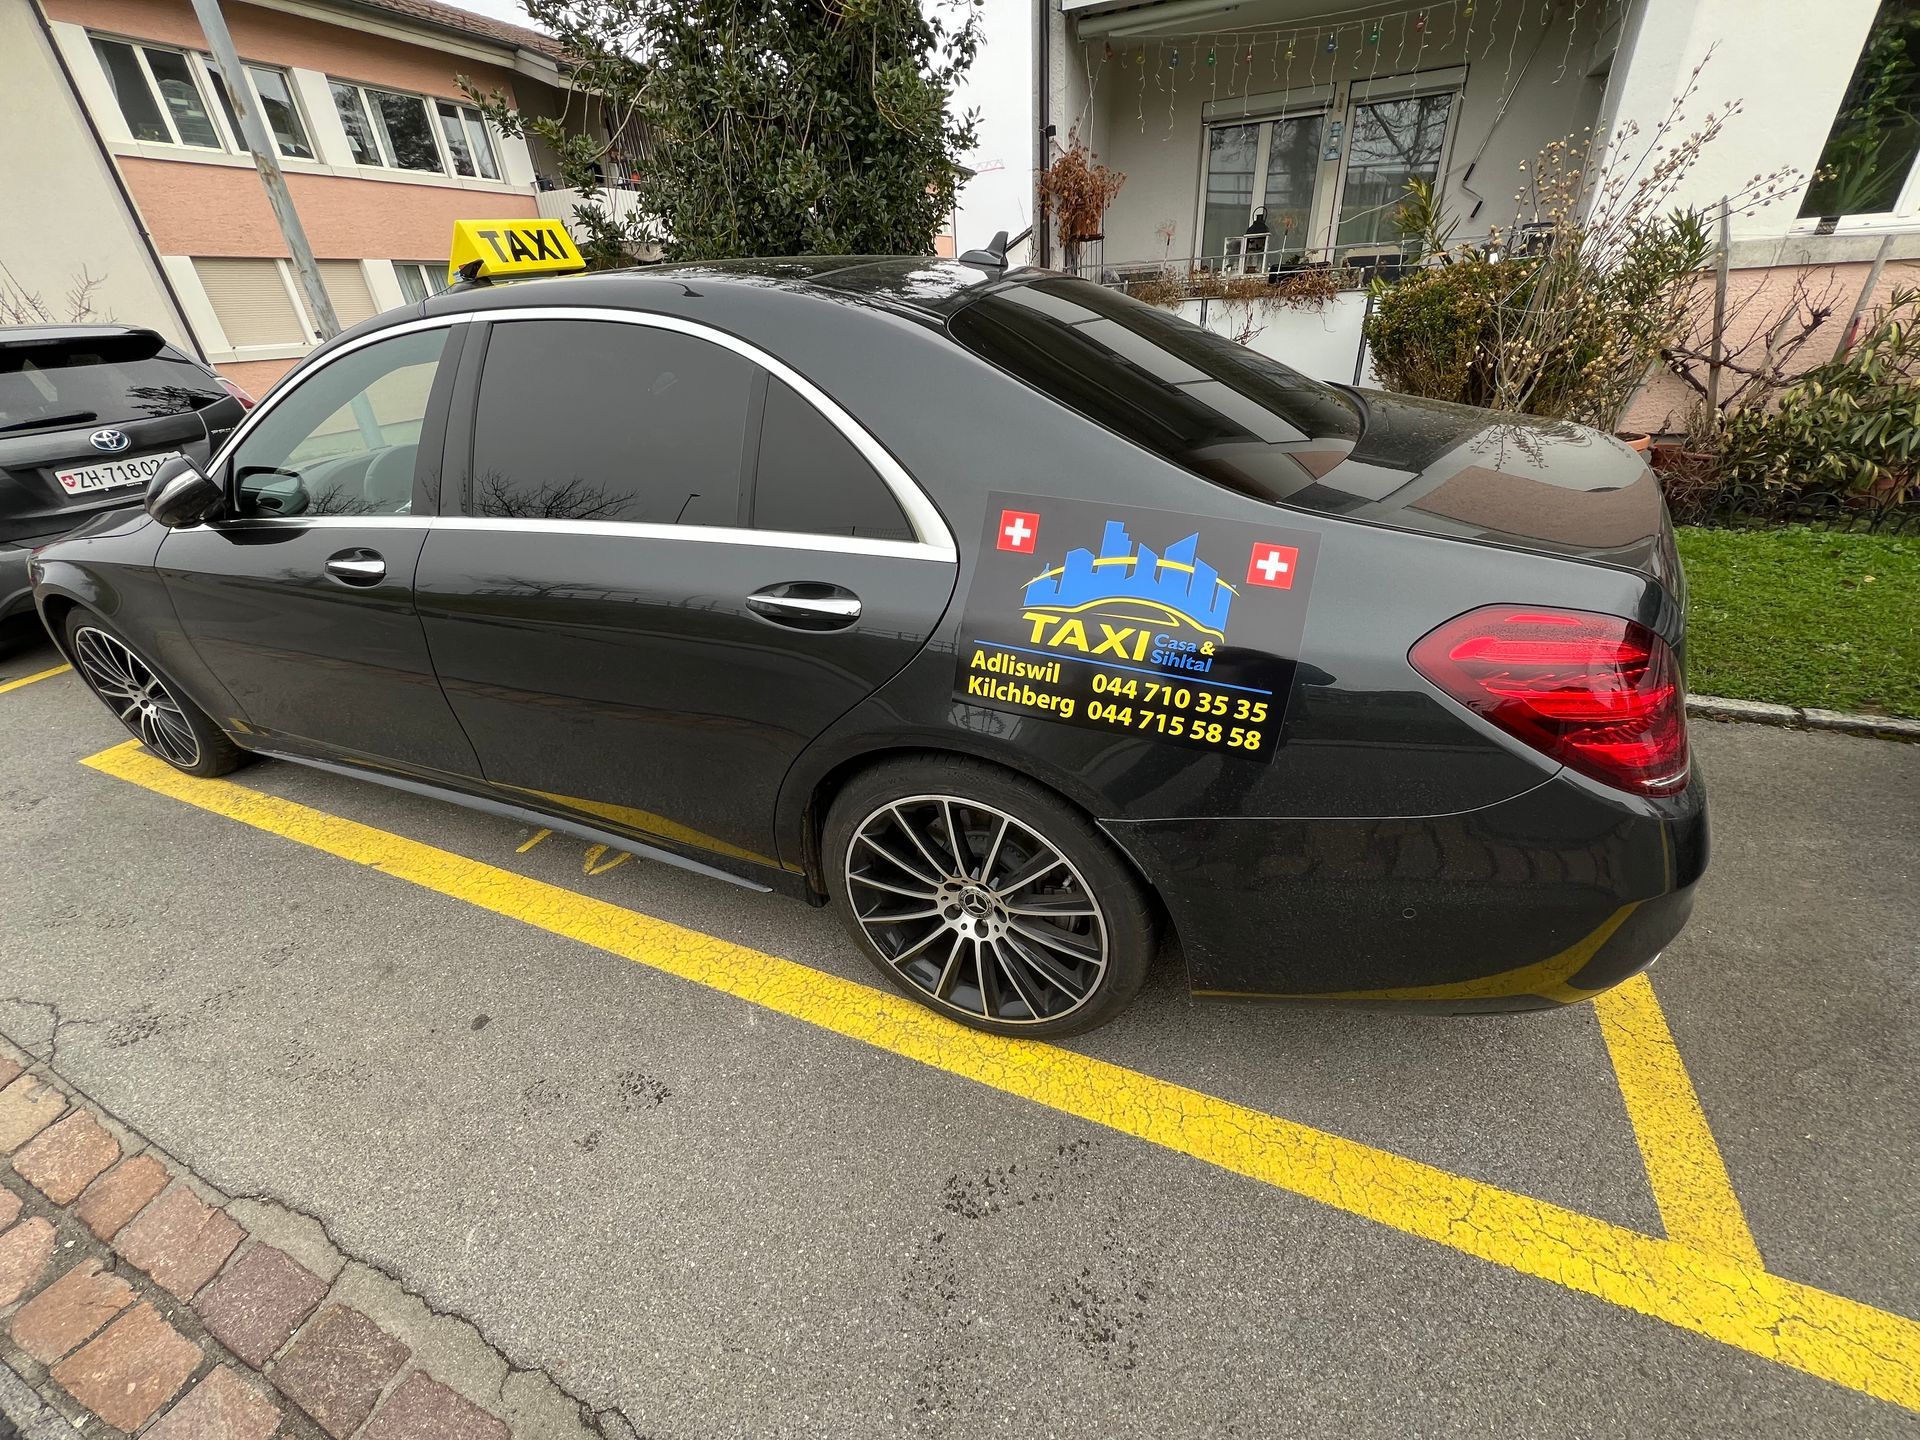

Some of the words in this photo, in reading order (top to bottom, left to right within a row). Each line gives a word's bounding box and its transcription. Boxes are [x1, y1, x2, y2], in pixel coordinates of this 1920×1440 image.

[477, 229, 569, 263] TAXI
[1022, 611, 1151, 662] TAXI
[1154, 633, 1197, 653] Casa
[1200, 641, 1217, 657] &
[1150, 650, 1213, 673] Sihltal
[970, 649, 1061, 684] Adliswil
[1091, 673, 1138, 700] 044
[1143, 682, 1191, 709] 710
[1195, 692, 1229, 716] 35
[1233, 699, 1269, 723] 35
[967, 675, 1076, 719] Kilchberg
[1087, 701, 1133, 727] 044
[1138, 710, 1185, 736] 715
[1189, 720, 1223, 743] 58
[1227, 727, 1262, 751] 58
